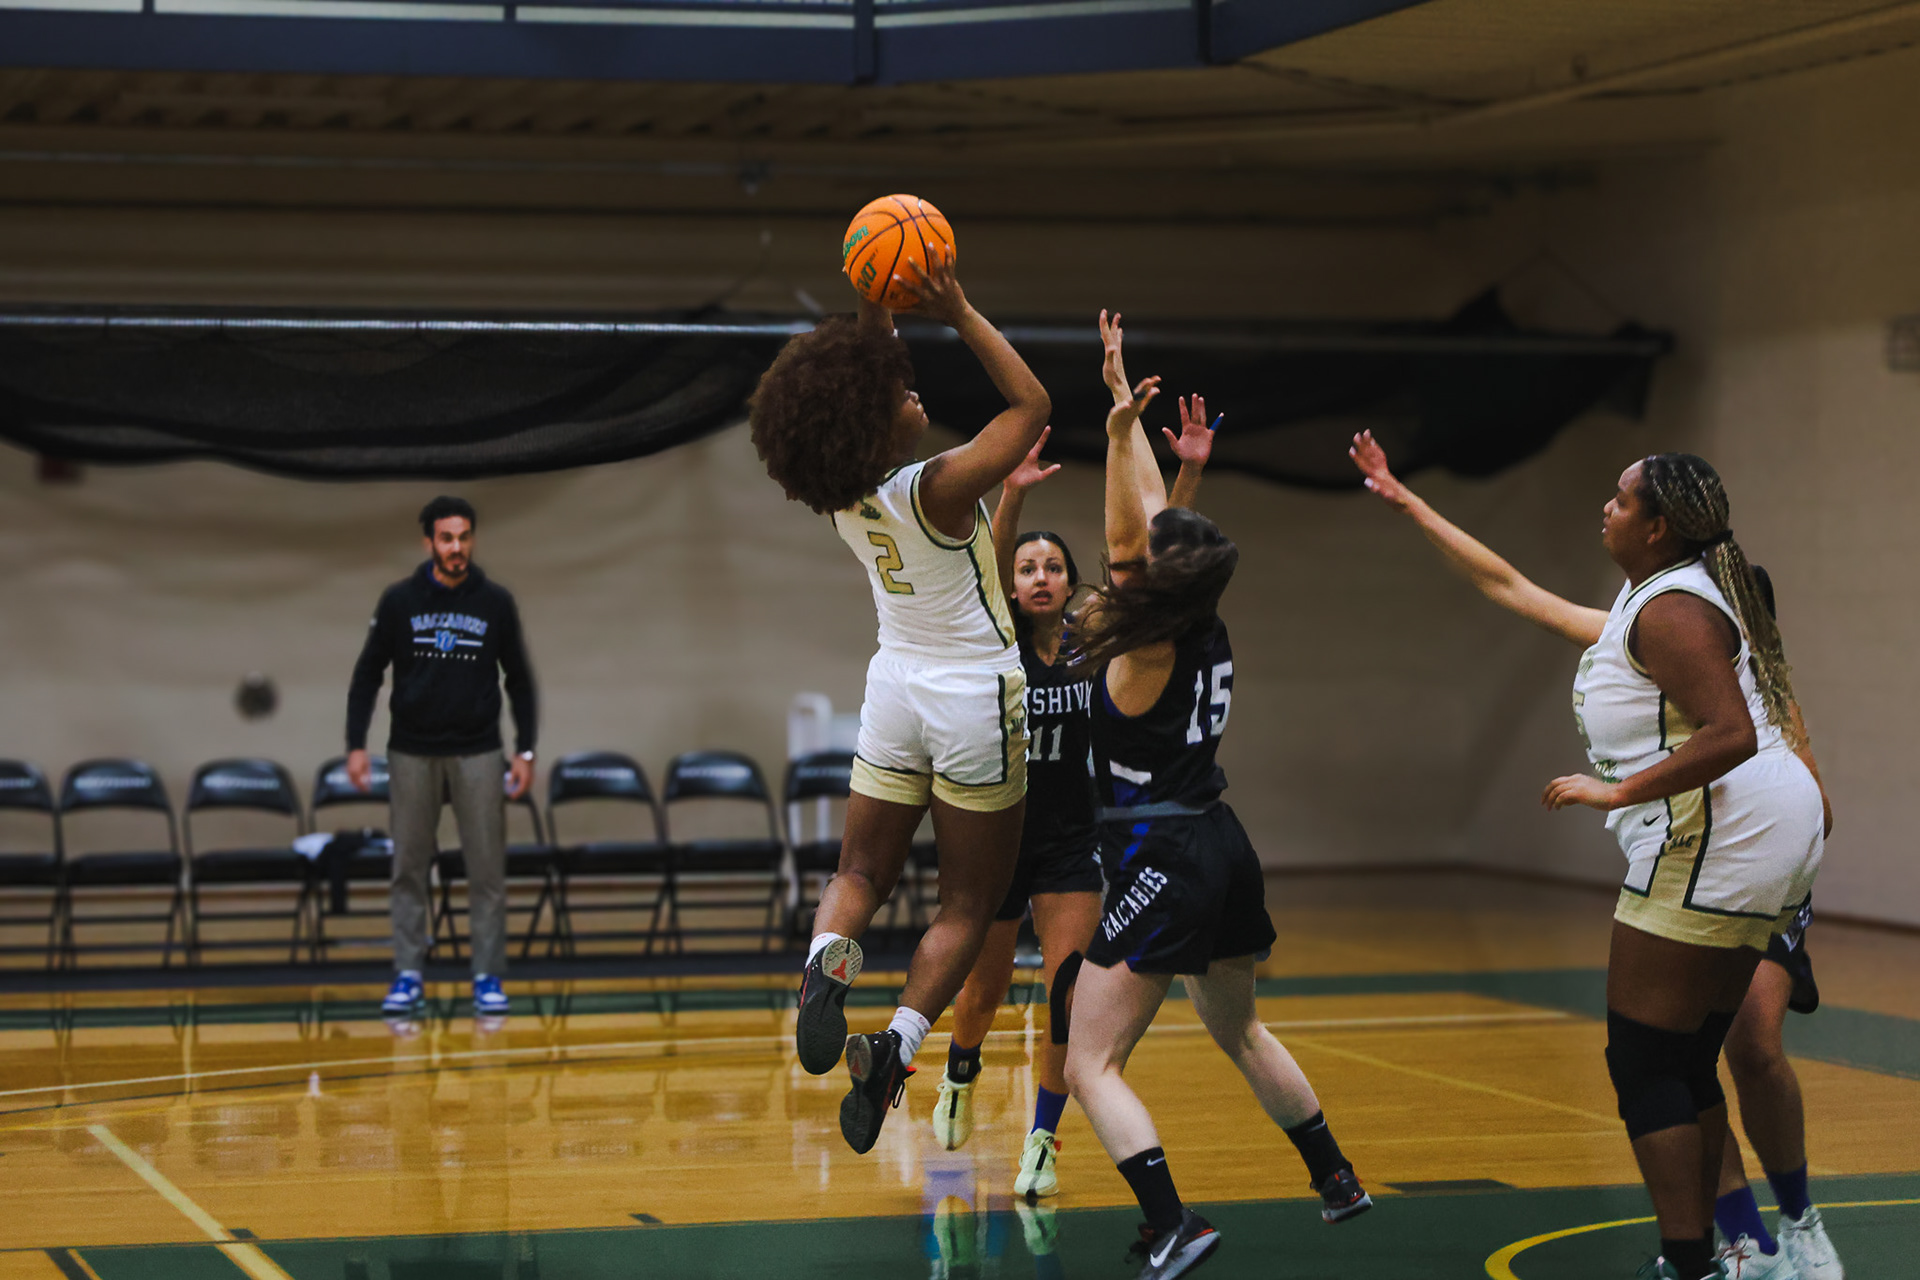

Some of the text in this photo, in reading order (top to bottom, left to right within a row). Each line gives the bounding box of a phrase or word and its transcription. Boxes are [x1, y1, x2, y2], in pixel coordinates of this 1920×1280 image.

[867, 531, 915, 595] 2
[1186, 660, 1233, 744] 15
[1029, 724, 1063, 761] 11
